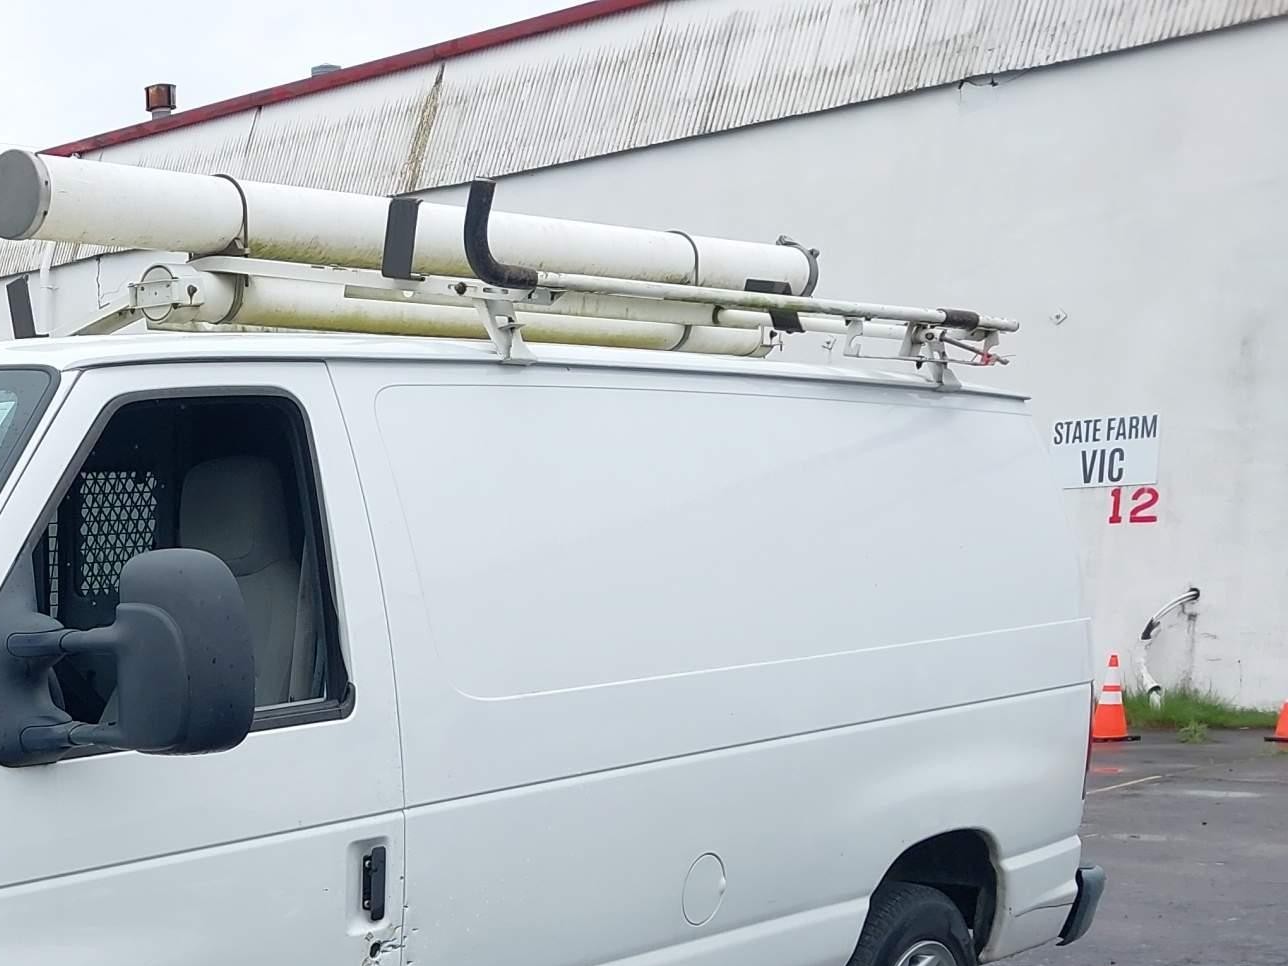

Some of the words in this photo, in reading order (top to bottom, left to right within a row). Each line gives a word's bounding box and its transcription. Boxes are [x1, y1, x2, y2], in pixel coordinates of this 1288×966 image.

[1053, 419, 1102, 445] STATE
[1106, 414, 1158, 441] FARM
[1081, 447, 1125, 484] VIC
[1108, 486, 1160, 524] 12
